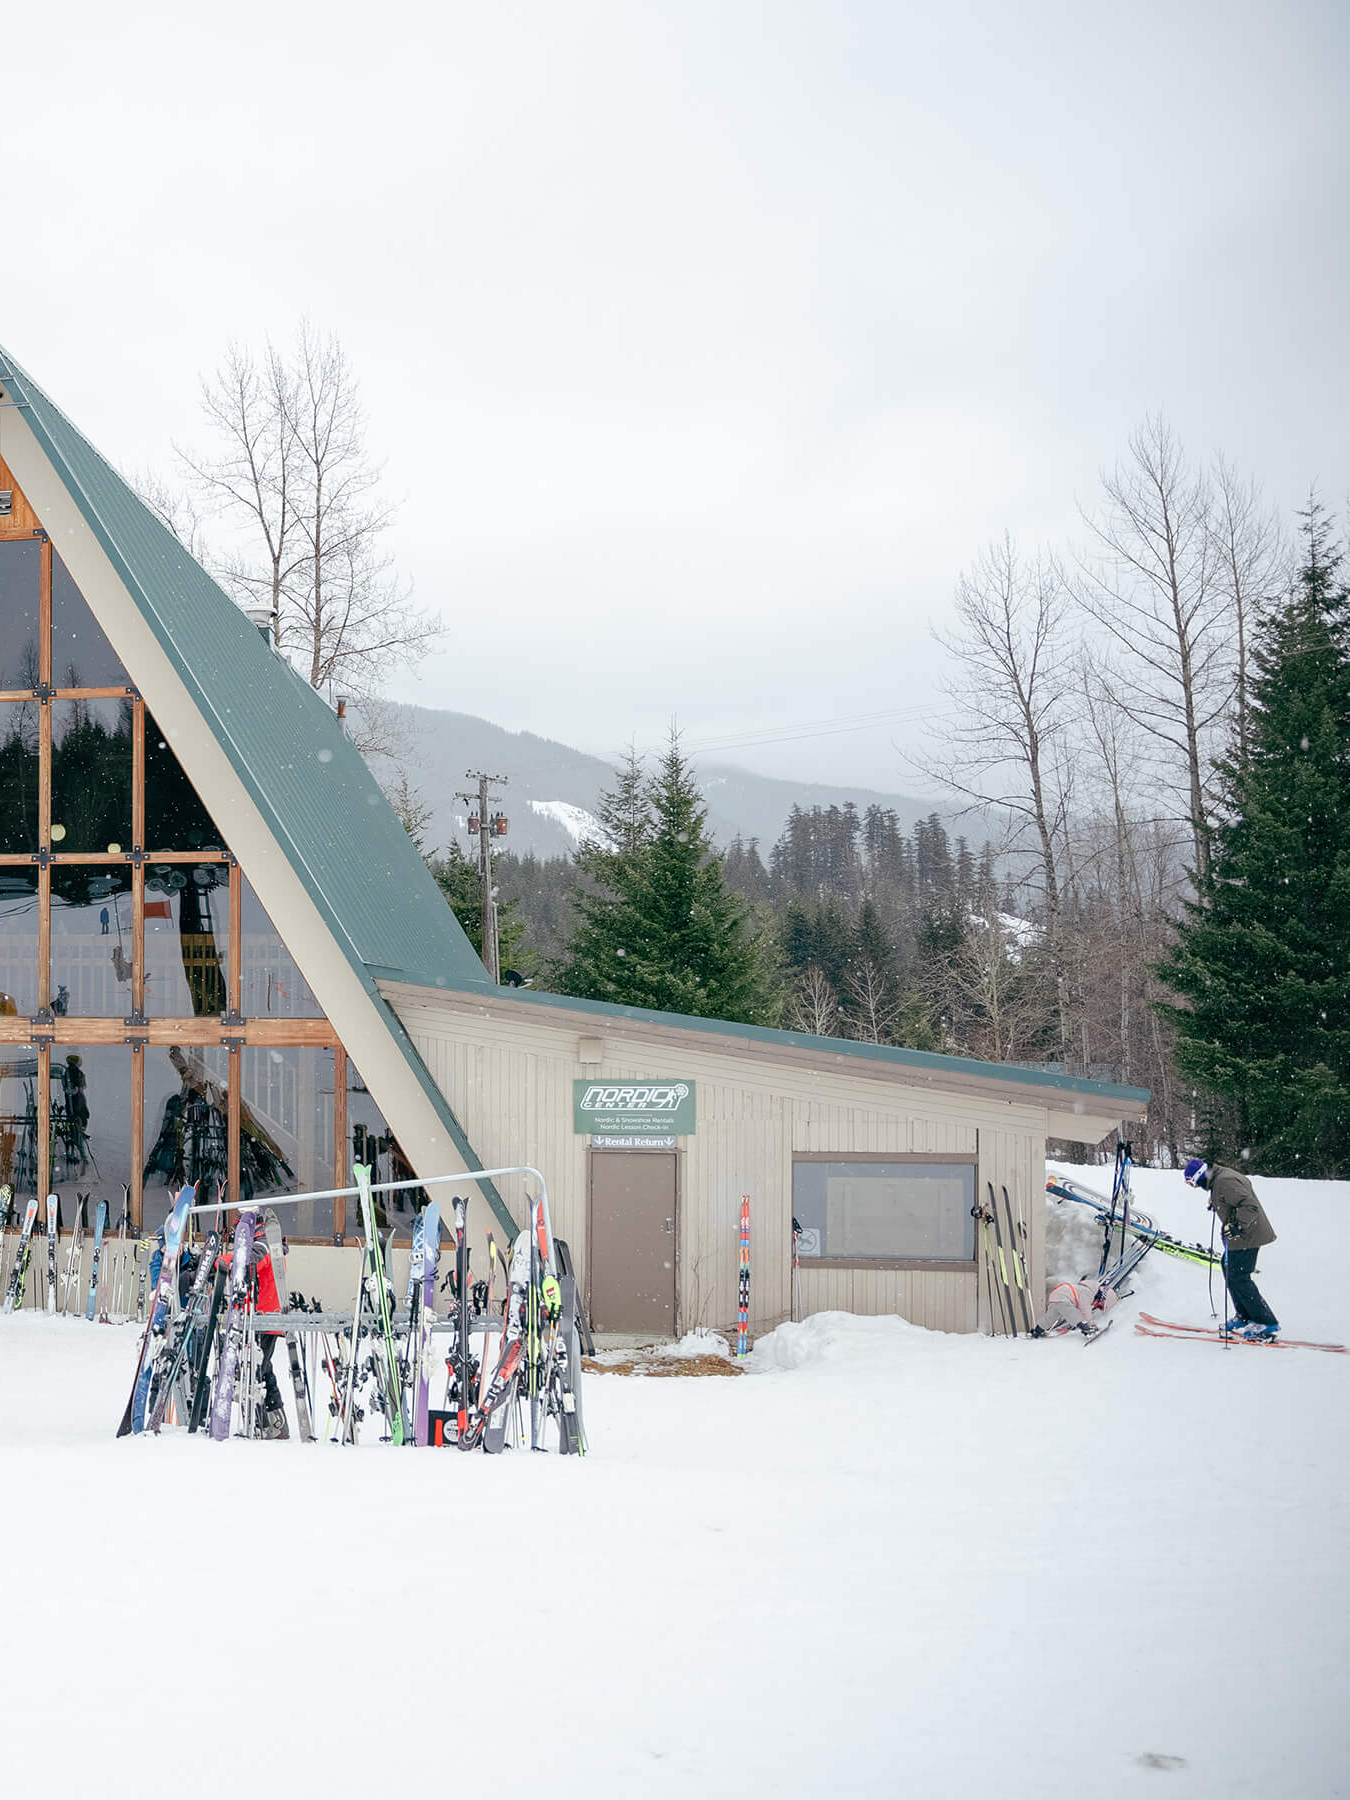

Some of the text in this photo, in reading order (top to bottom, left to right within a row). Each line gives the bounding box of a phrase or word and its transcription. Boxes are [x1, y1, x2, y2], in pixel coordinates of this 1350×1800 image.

[585, 1088, 670, 1102] NORDIC
[605, 1137, 664, 1146] Rental Return
